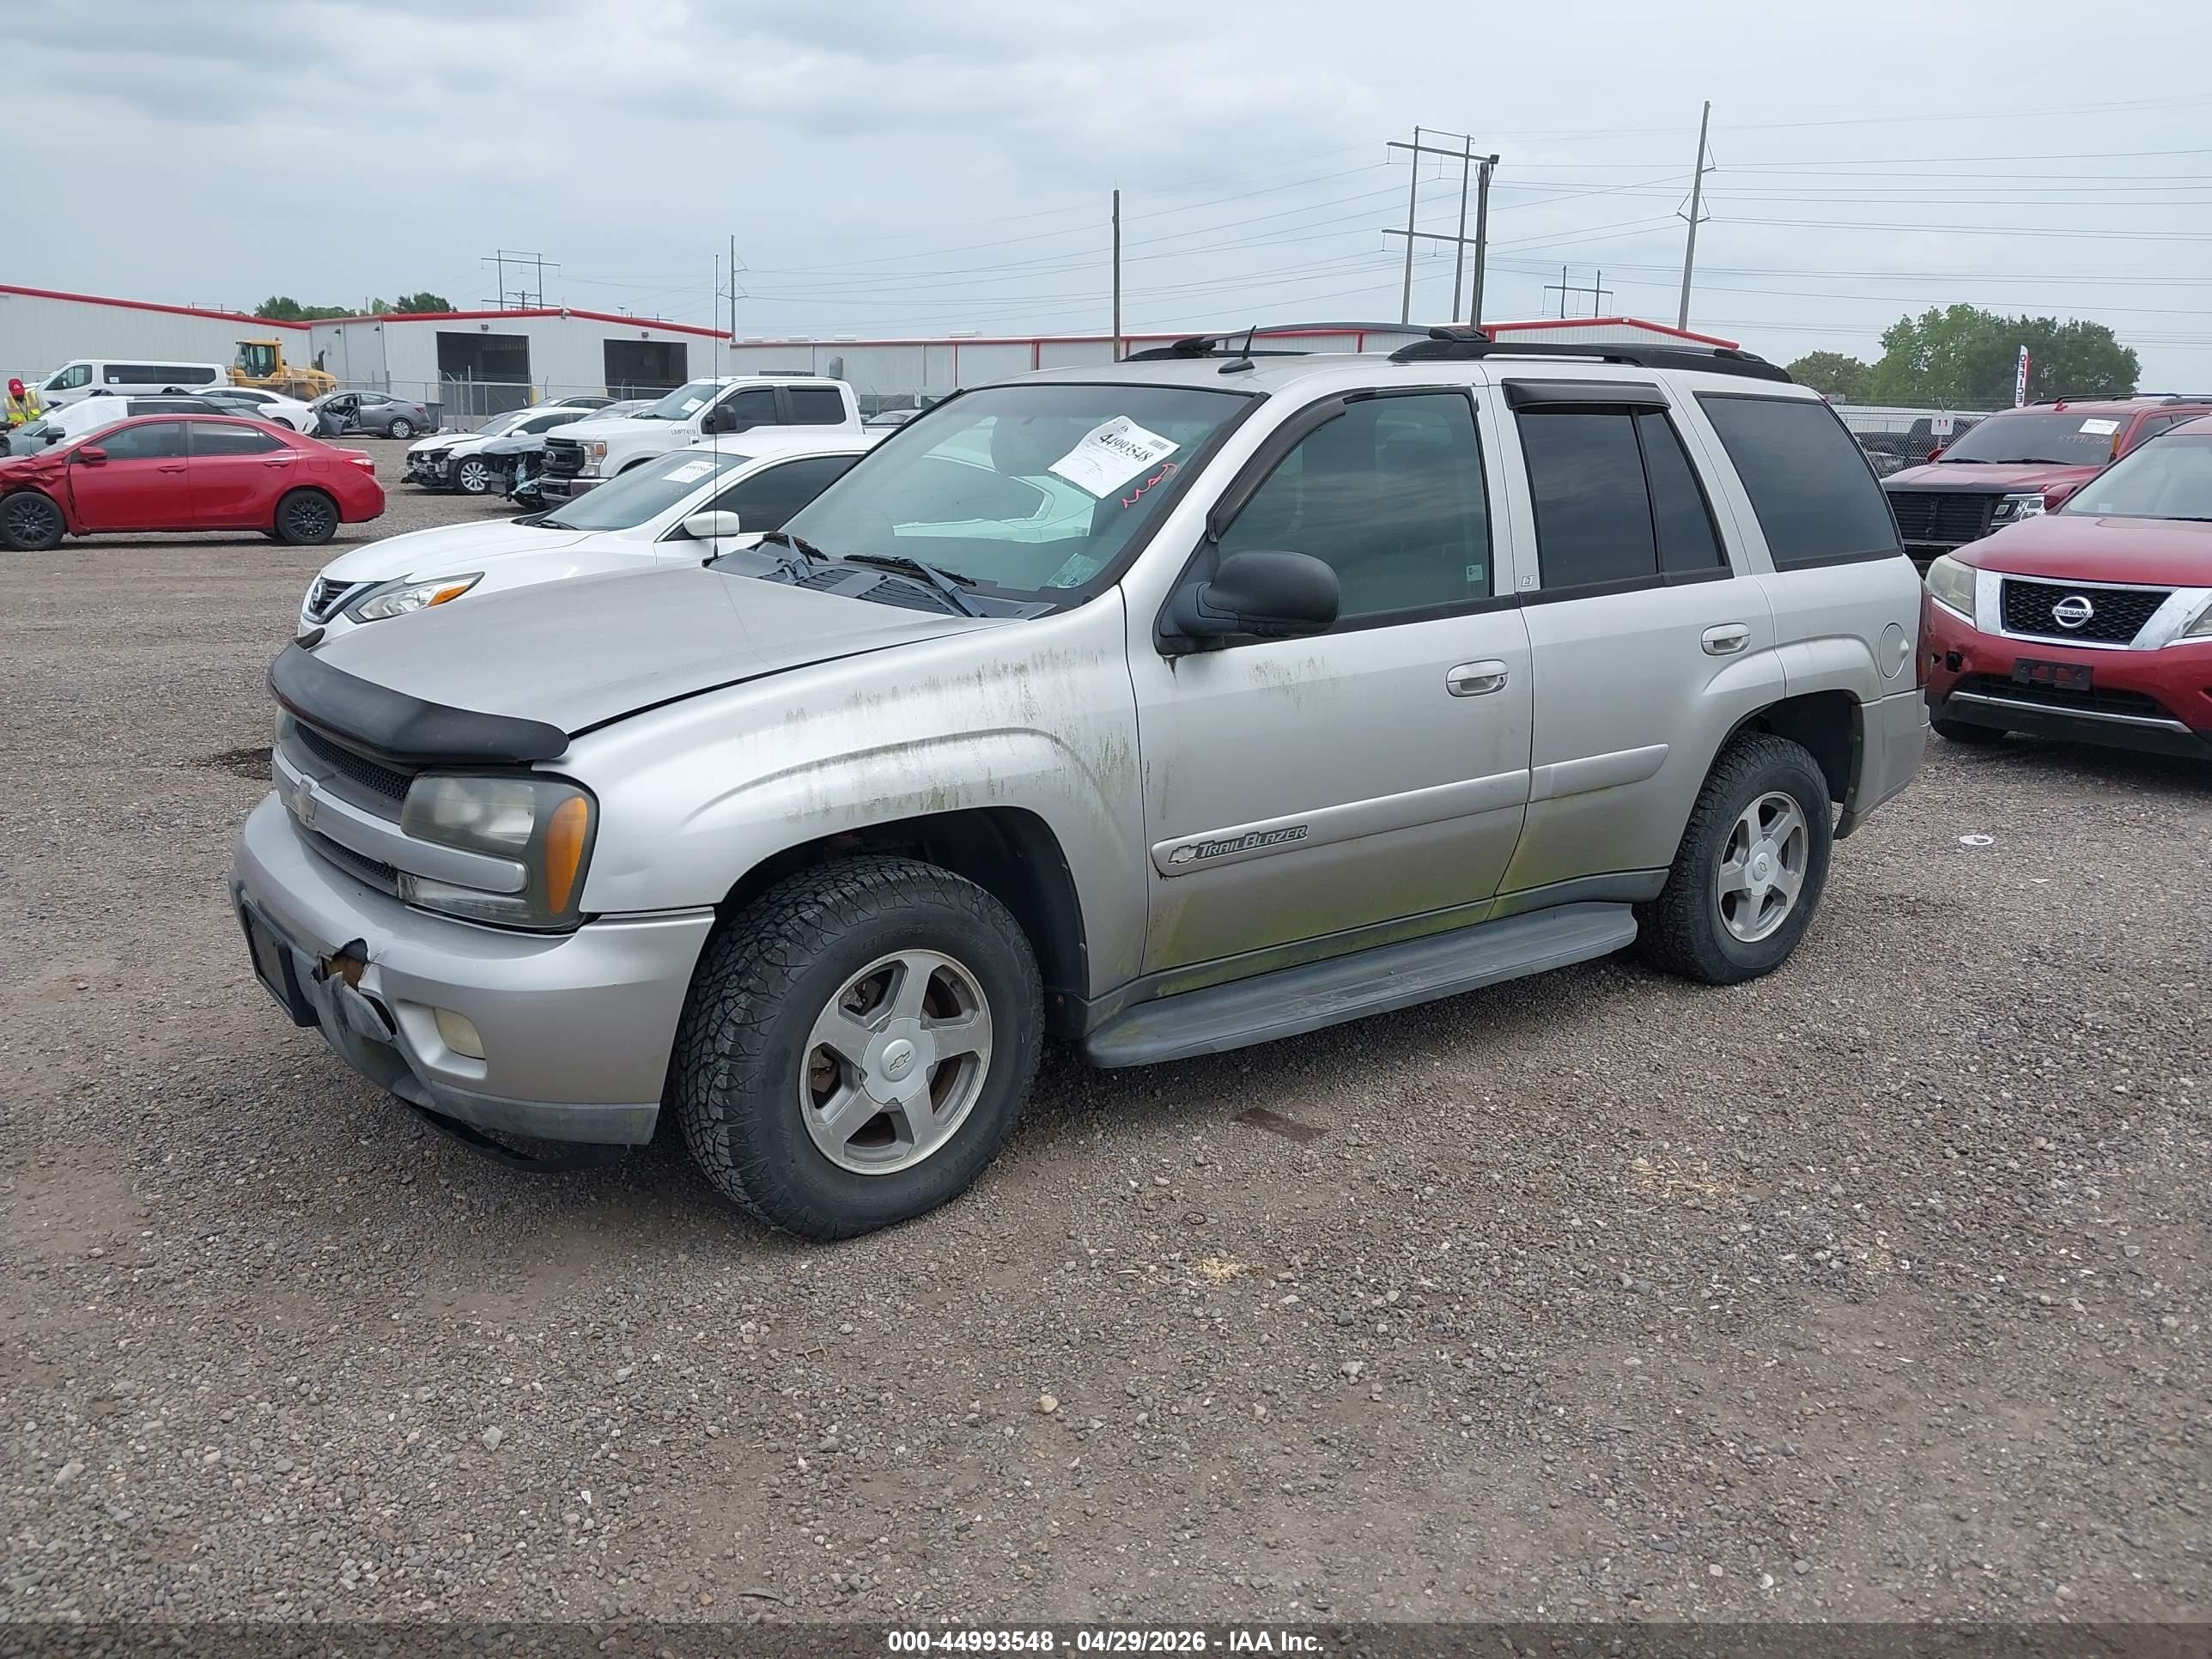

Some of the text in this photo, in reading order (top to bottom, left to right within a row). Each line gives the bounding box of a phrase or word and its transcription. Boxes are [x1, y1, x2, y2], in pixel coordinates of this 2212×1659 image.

[1936, 418, 1948, 427] 11
[1099, 433, 1154, 462] 44993548
[1521, 574, 1536, 587] LT
[2054, 608, 2088, 617] NISSAN
